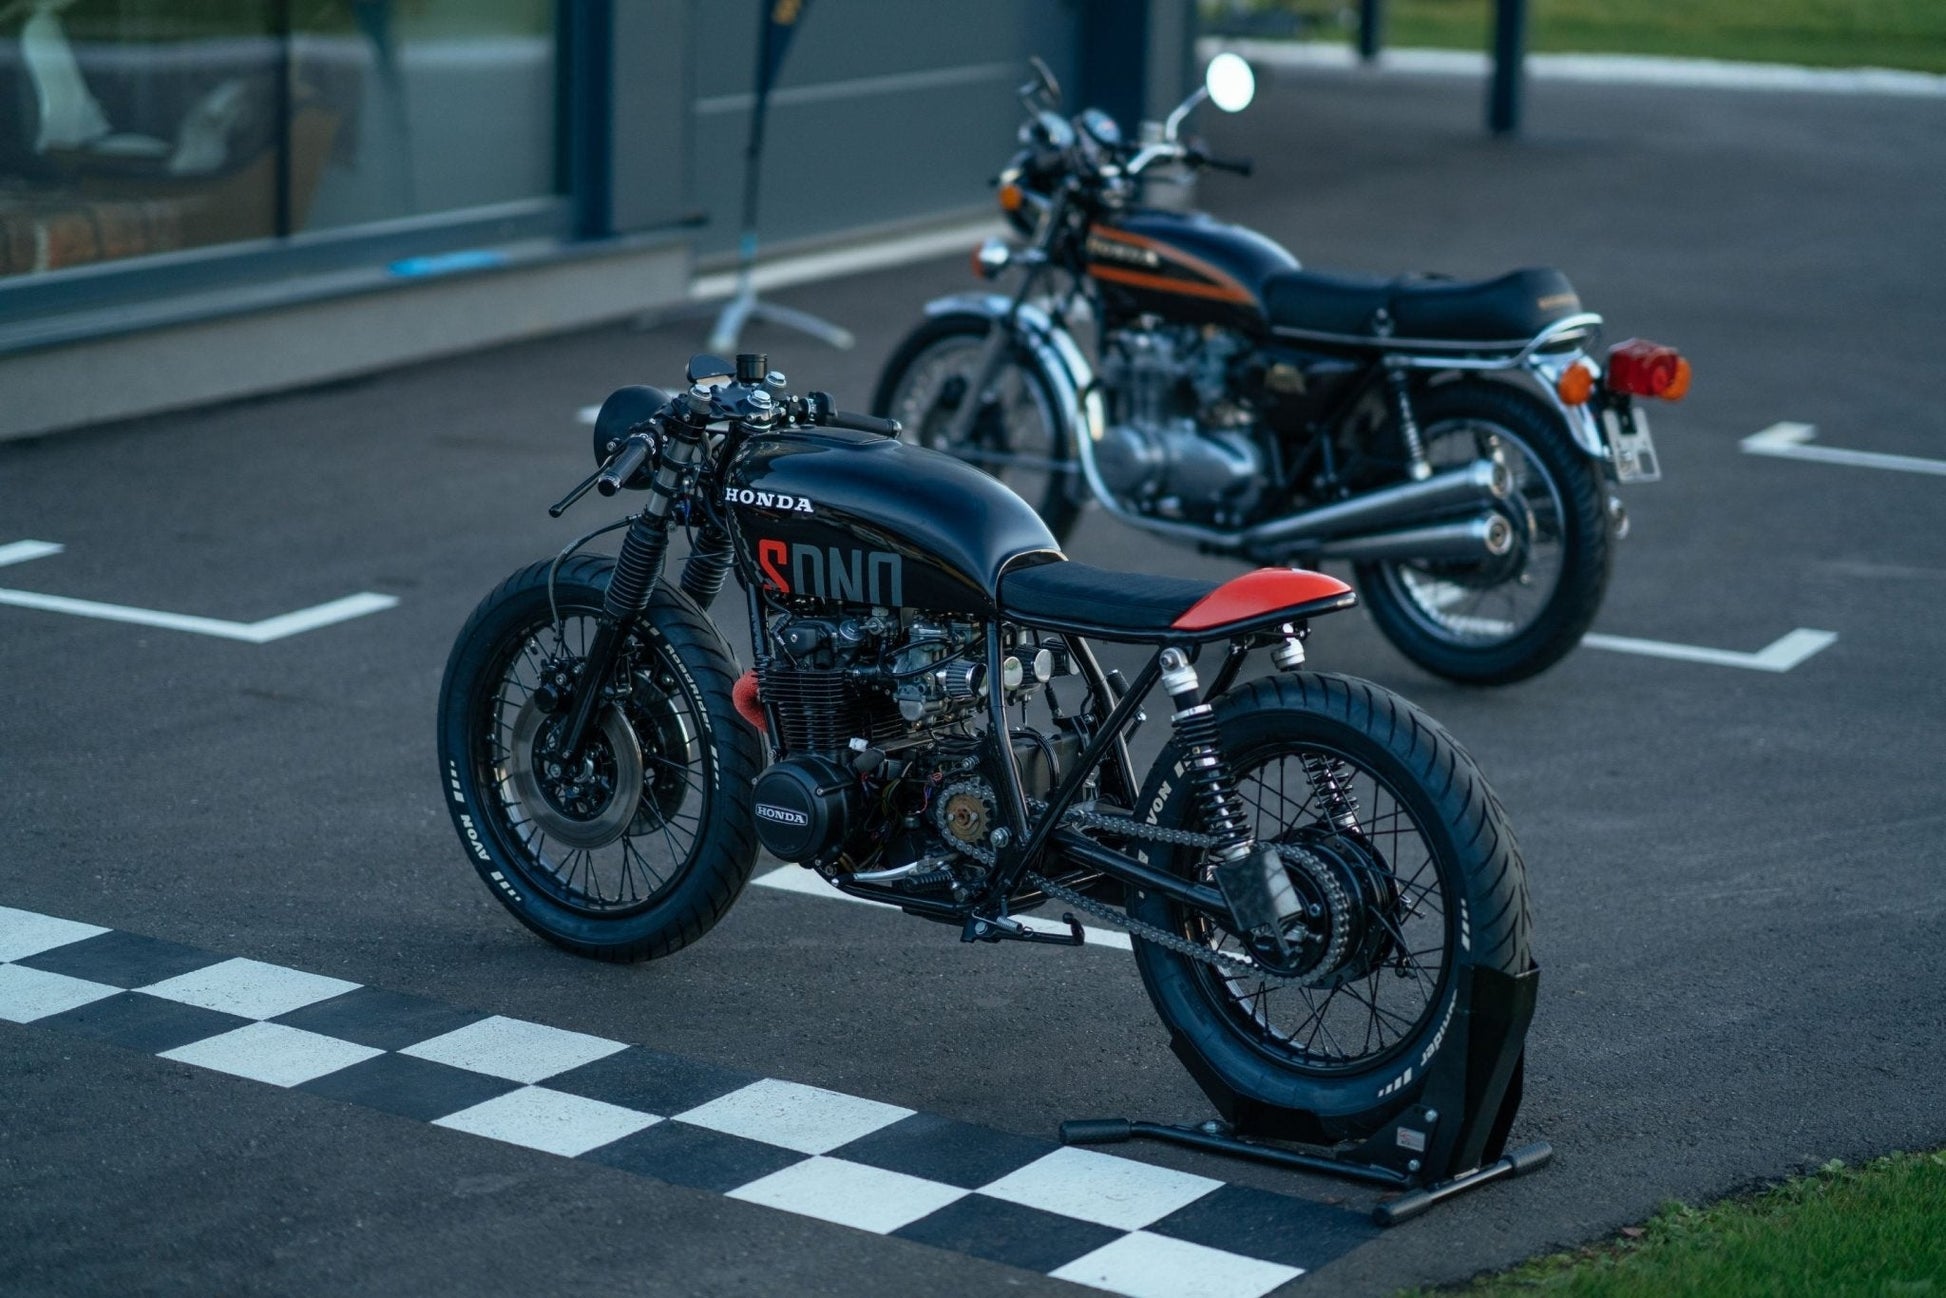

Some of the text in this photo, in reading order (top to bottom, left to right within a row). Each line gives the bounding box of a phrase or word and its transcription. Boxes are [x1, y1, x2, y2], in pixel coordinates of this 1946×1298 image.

[725, 486, 814, 513] HONDA
[757, 806, 805, 824] HONDA
[1144, 780, 1173, 828] VON
[460, 814, 491, 861] AVON
